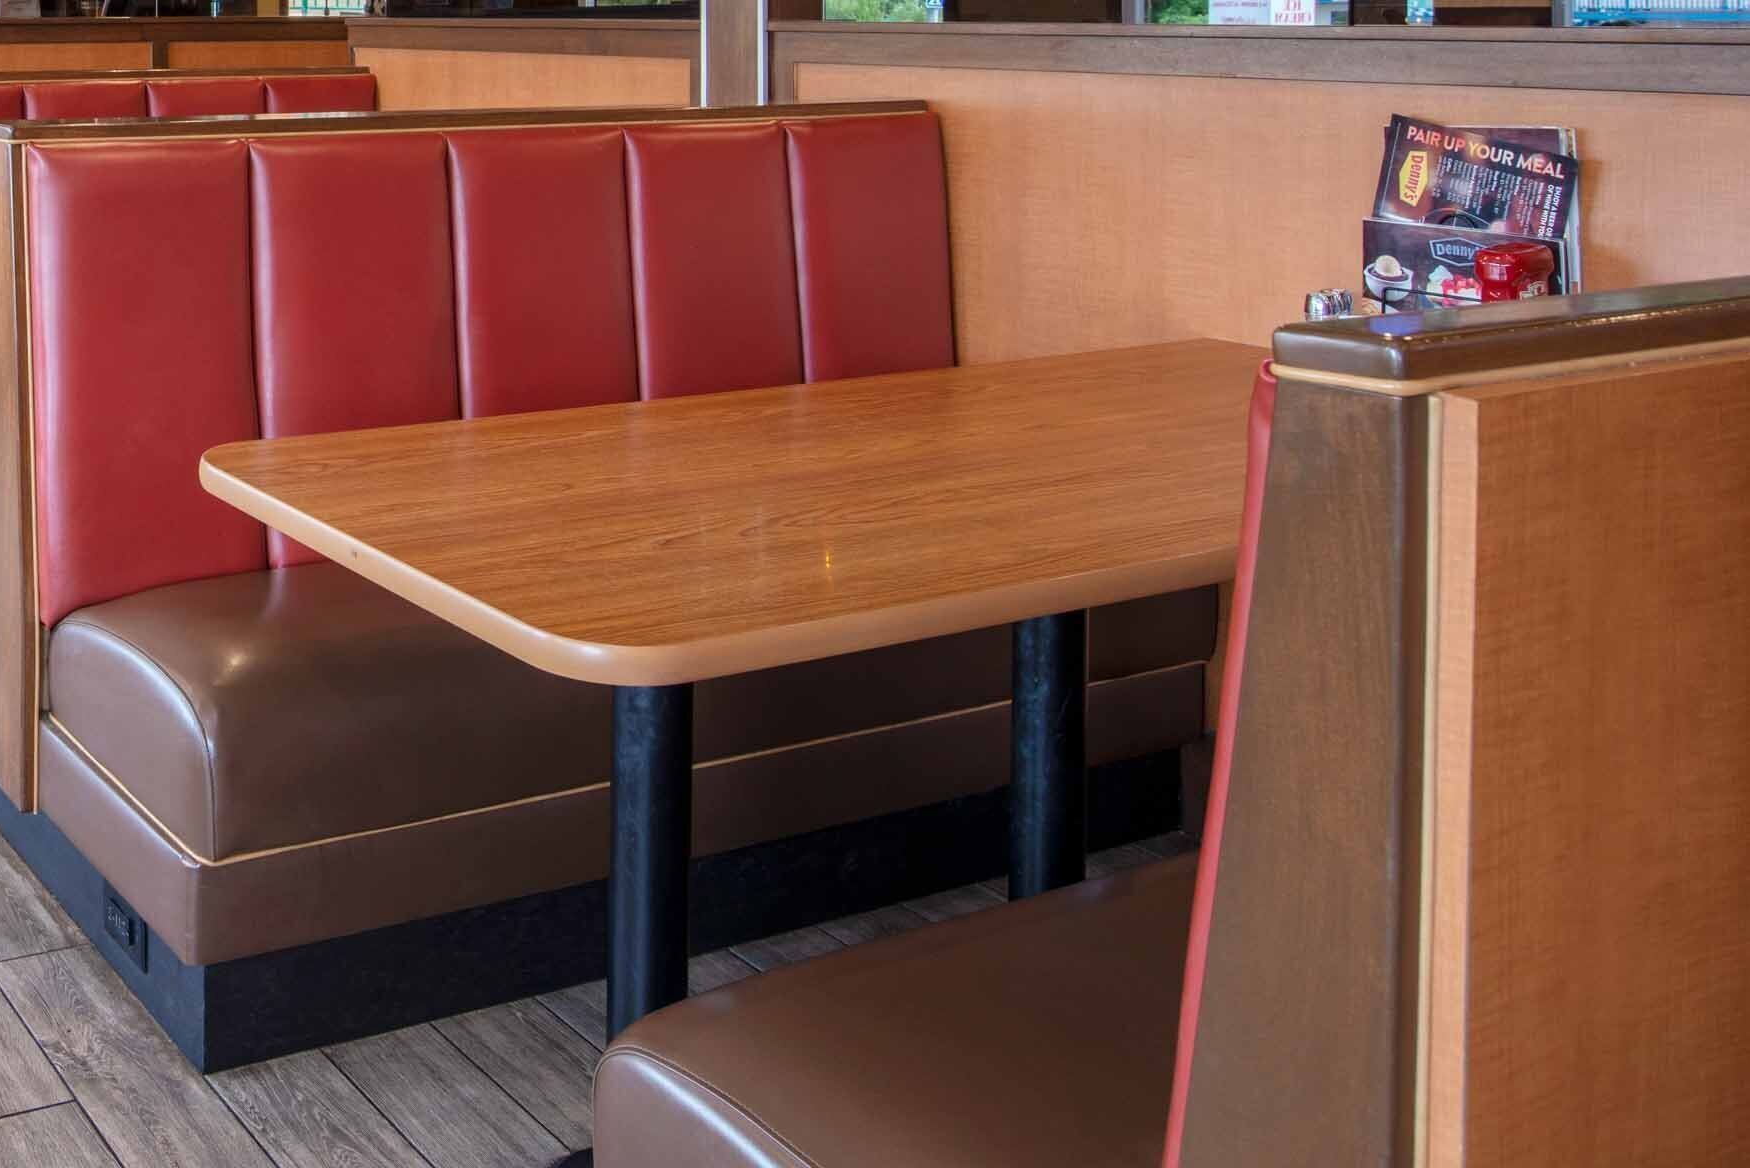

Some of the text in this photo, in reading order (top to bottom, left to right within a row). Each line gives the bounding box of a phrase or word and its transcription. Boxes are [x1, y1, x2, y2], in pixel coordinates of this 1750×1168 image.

[1406, 126, 1565, 179] PAIR UP YOUR MEAL
[1403, 154, 1424, 202] Denny's
[1552, 186, 1562, 207] ENJOY
